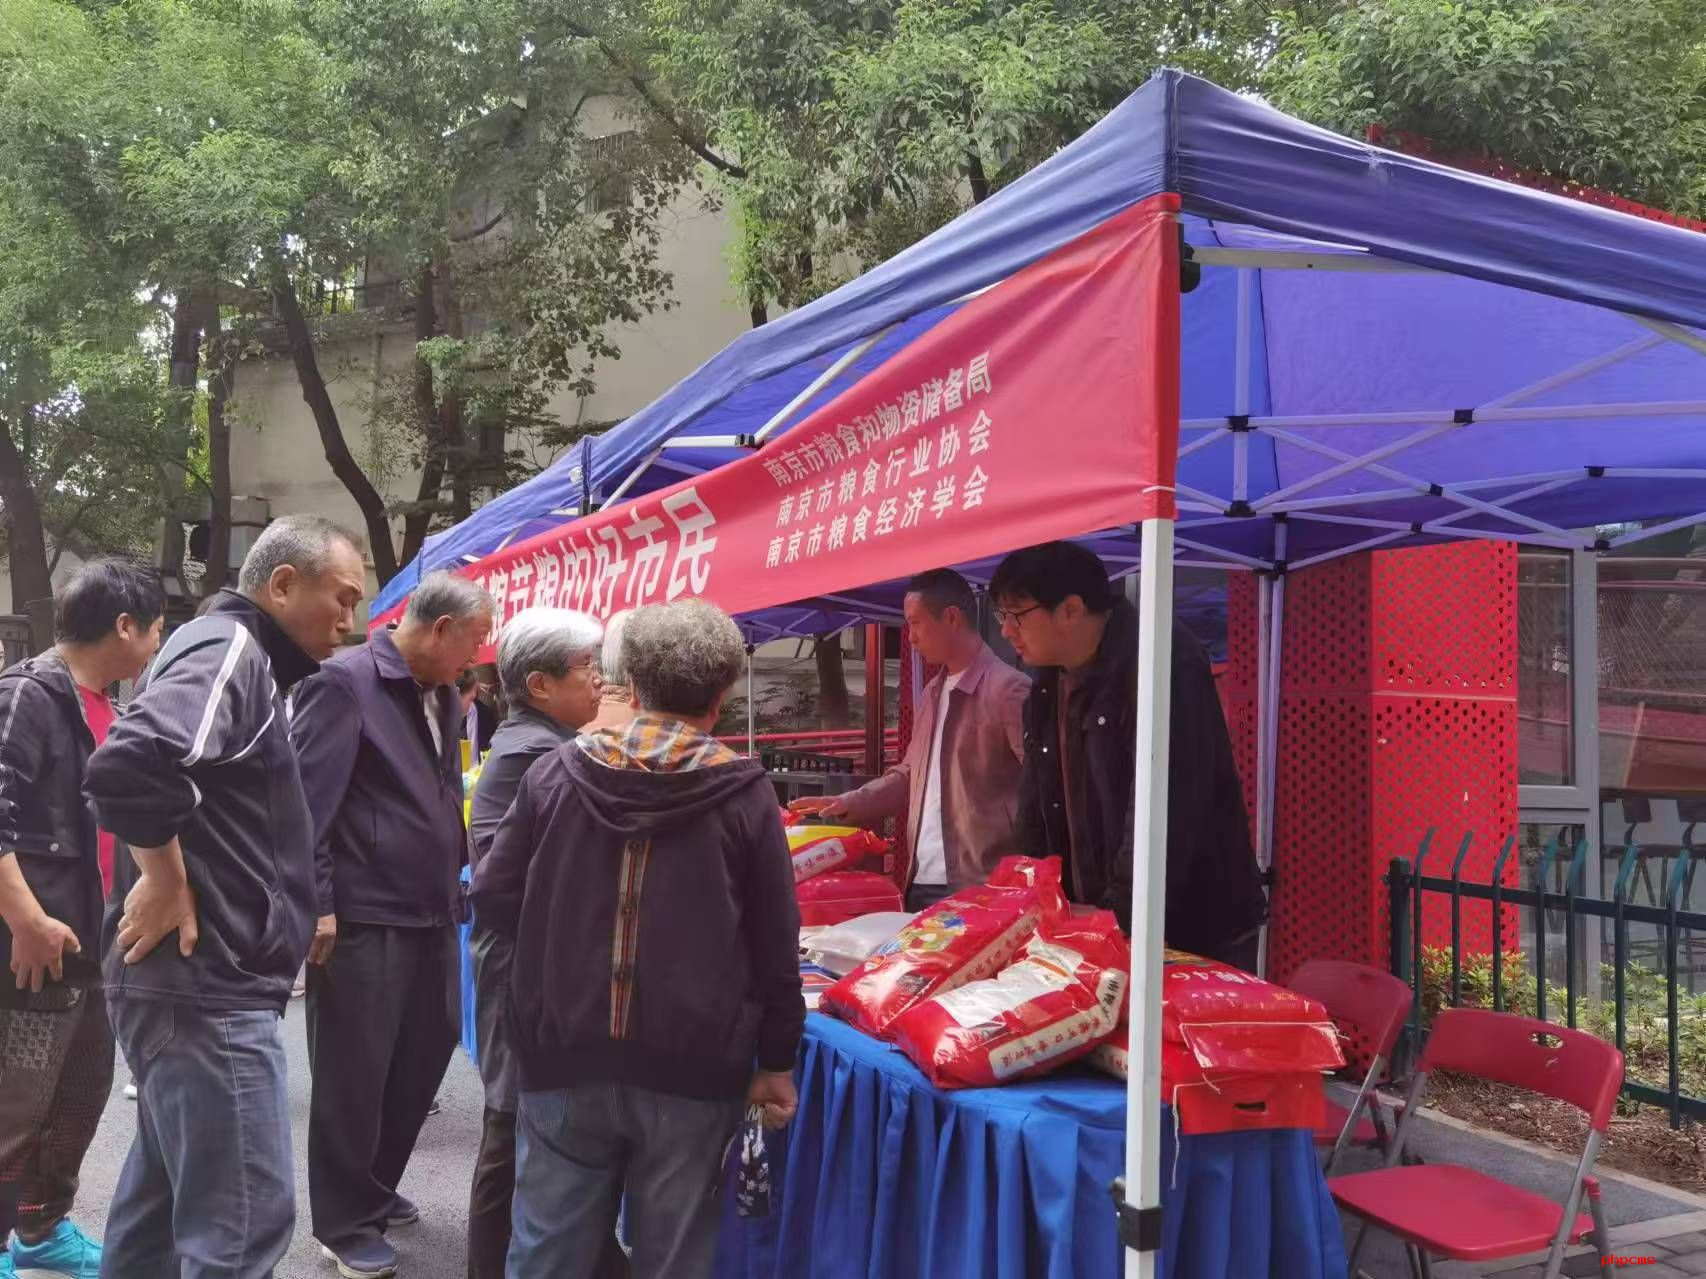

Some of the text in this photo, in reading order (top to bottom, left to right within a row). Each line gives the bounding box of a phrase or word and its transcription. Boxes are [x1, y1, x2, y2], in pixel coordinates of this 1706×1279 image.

[762, 351, 993, 488] 南京市粮食和物资储备局
[776, 410, 993, 528] 南京市粮食行业协会
[475, 486, 718, 646] 粮节粮的好市民
[765, 465, 989, 568] 南京市粮食经济学会
